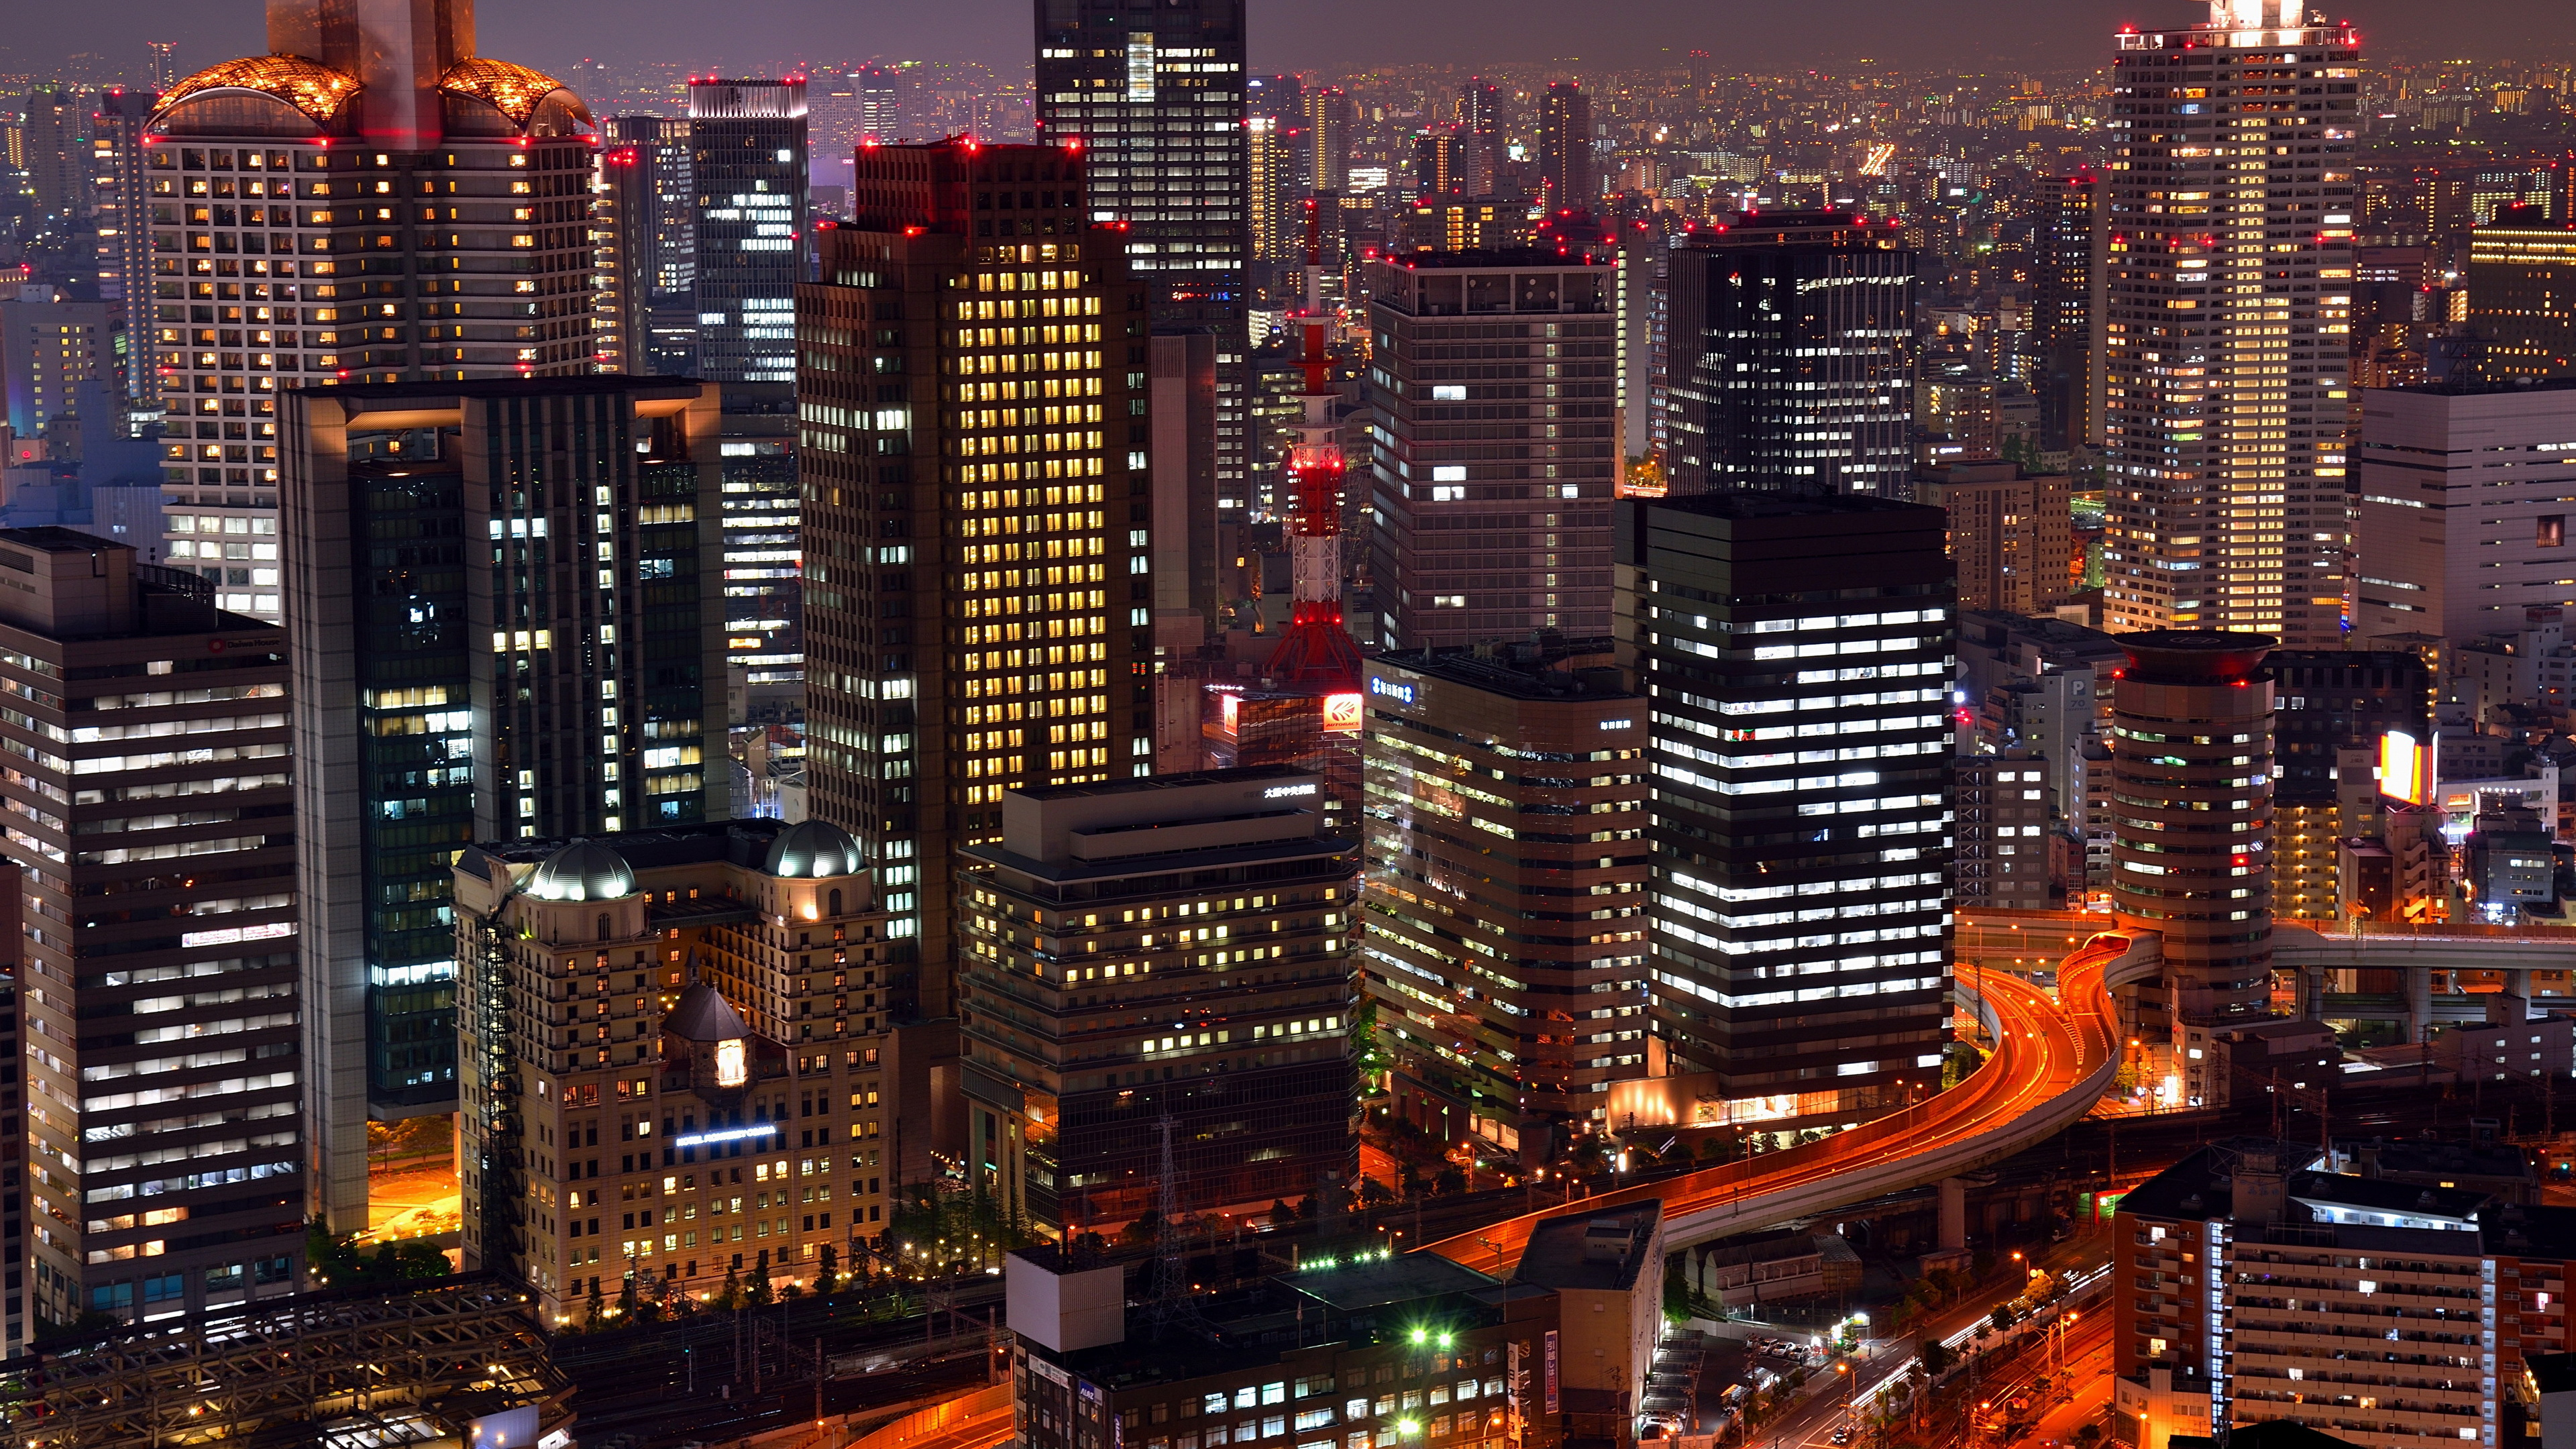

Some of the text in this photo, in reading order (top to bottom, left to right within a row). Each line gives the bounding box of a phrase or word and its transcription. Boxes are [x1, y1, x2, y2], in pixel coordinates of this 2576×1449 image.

[227, 641, 254, 649] Daiwa
[1380, 680, 1404, 700] 毎日新聞
[2073, 680, 2084, 696] P
[1600, 719, 1631, 731] 毎日新聞
